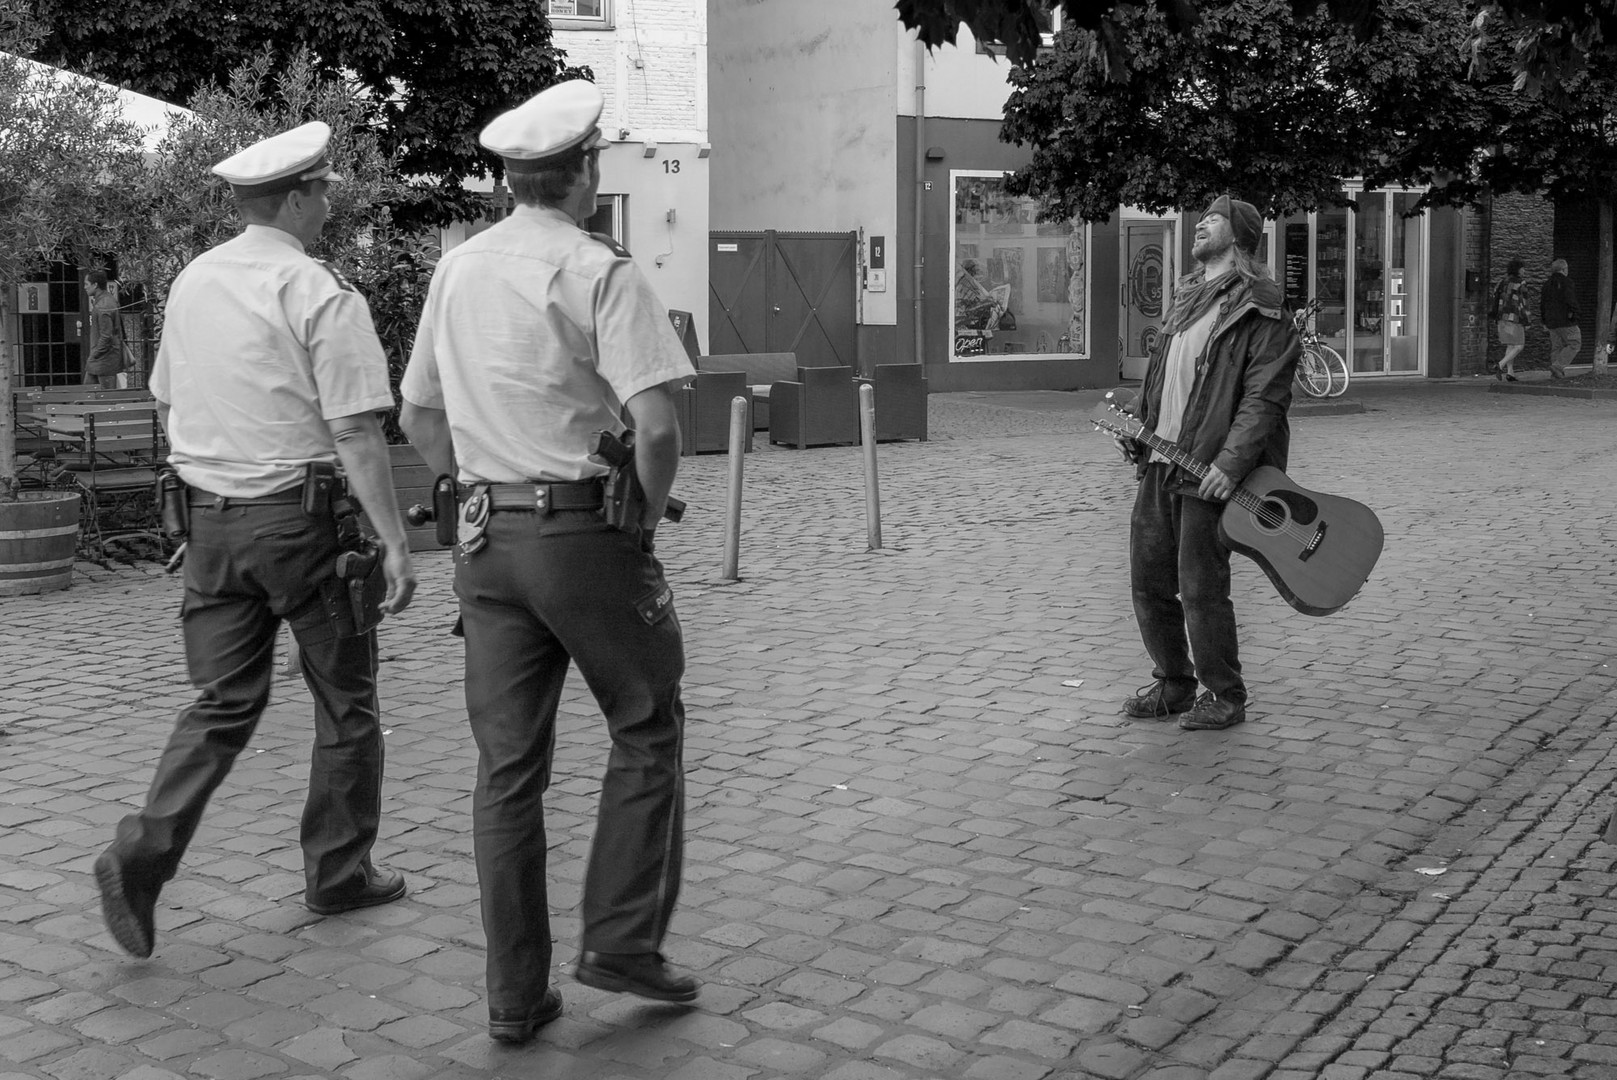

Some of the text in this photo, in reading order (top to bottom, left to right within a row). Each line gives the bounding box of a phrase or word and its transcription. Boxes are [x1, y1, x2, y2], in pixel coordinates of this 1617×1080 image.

[662, 159, 681, 174] 13
[875, 246, 881, 257] 12
[956, 338, 983, 352] Open
